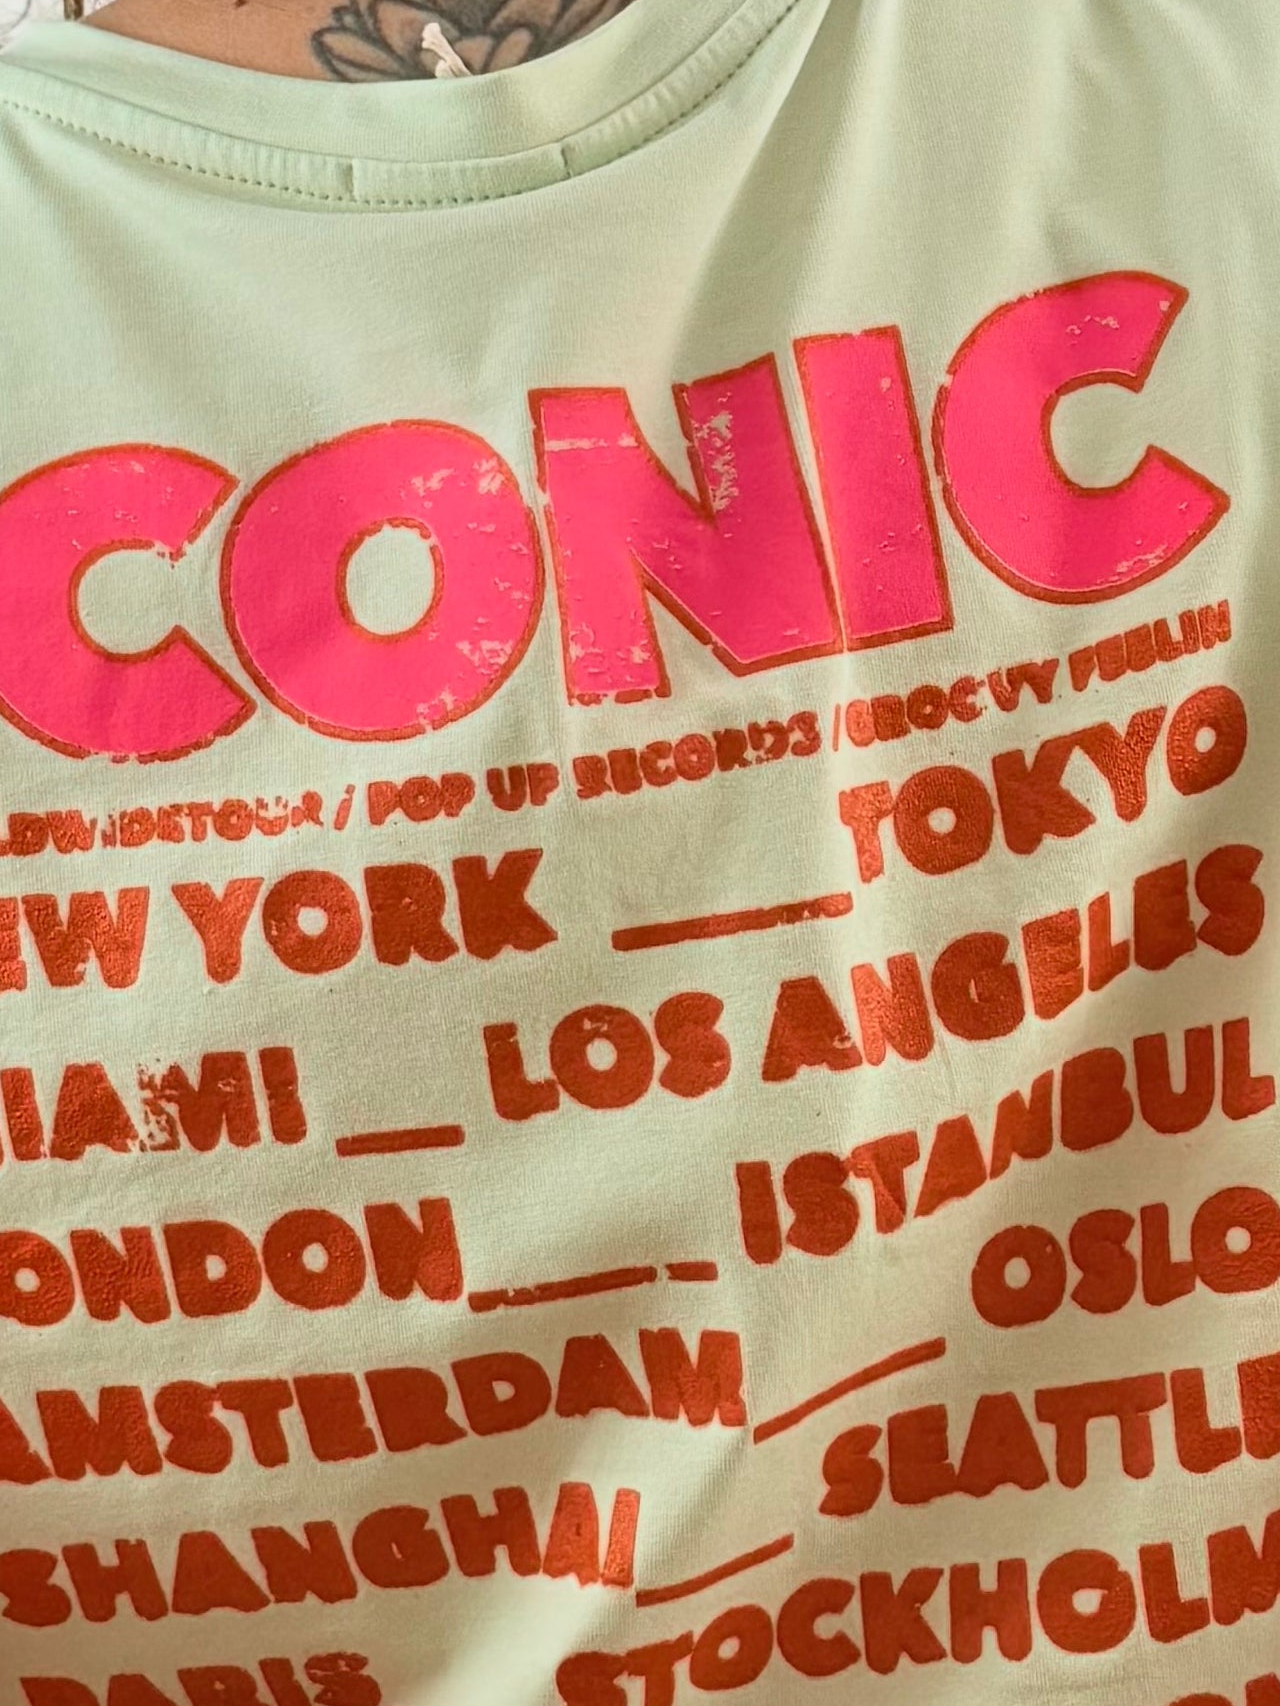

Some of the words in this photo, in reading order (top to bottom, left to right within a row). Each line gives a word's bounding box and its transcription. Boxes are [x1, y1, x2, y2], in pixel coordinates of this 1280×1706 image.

[171, 850, 555, 983] YORK
[838, 685, 1247, 883] TOKYO
[367, 773, 474, 825] POP
[486, 764, 558, 811] UP
[573, 712, 820, 799] RECORDS
[1068, 601, 1230, 691] FEELIN
[483, 992, 730, 1121] LOS
[762, 845, 1264, 1082] ANGELES
[735, 1019, 1275, 1265] ISTANBUL
